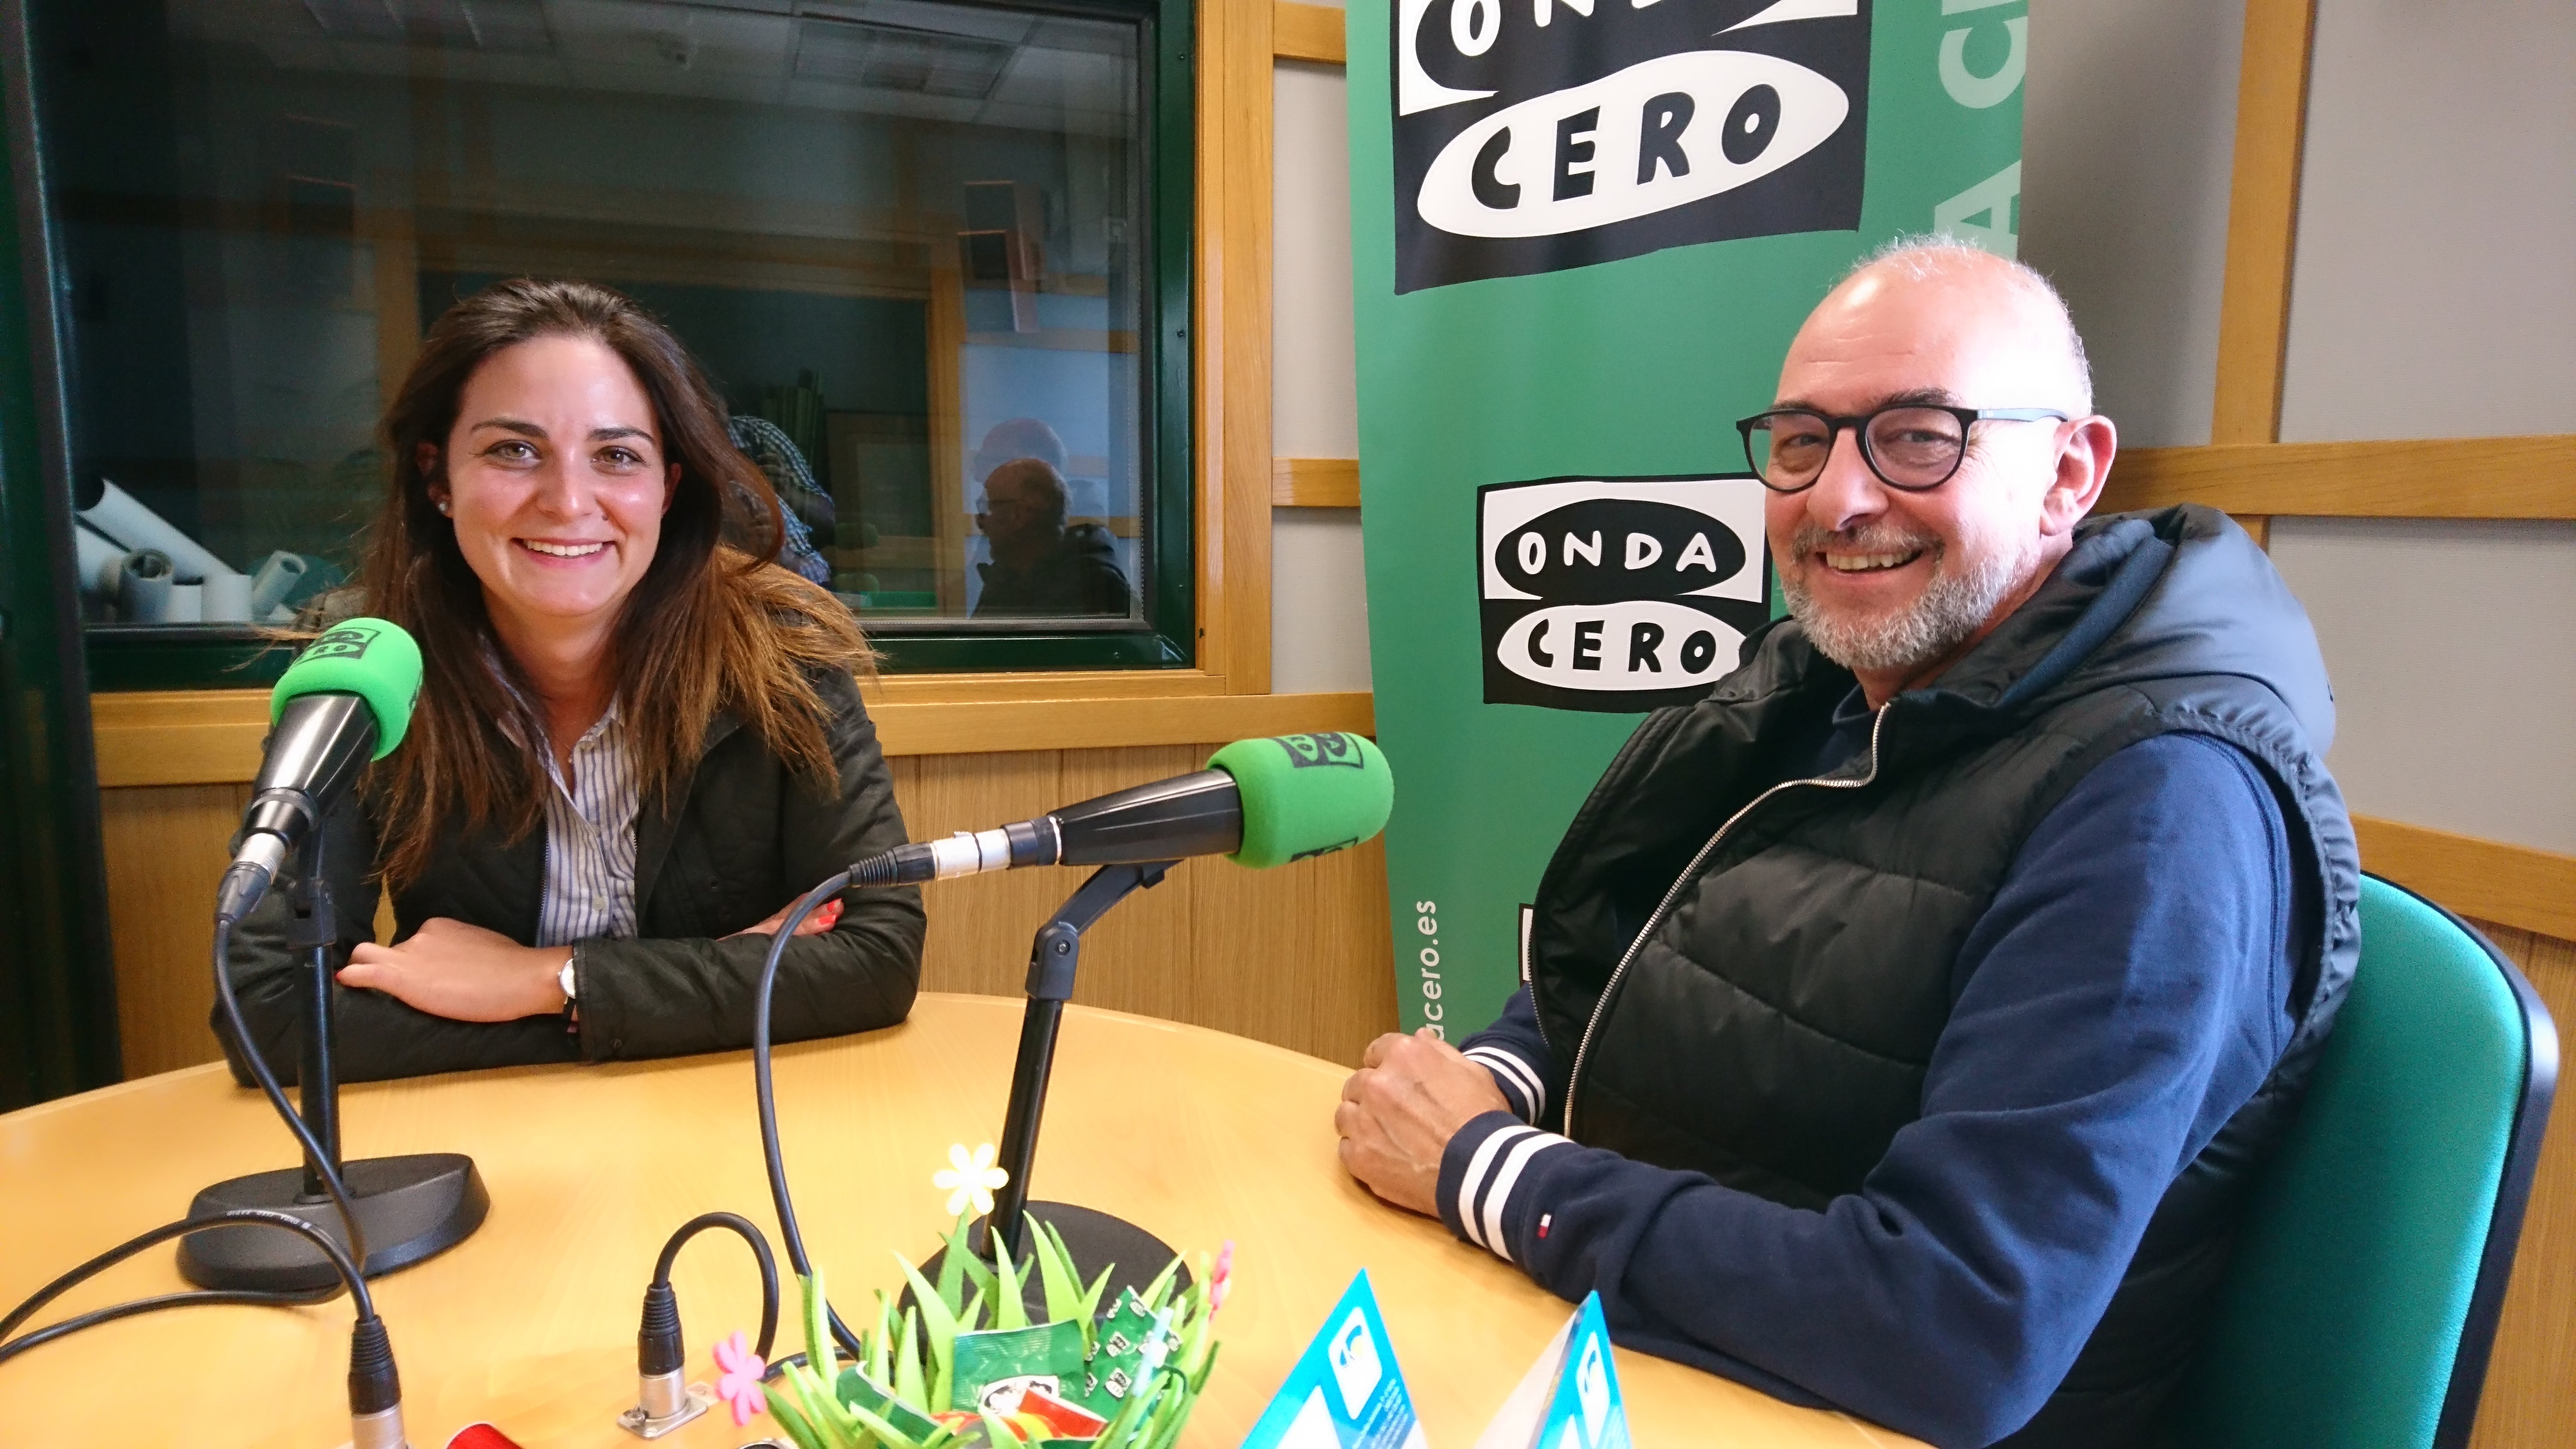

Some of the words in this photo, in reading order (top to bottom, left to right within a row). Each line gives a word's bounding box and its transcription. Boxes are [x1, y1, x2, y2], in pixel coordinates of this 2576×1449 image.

[1470, 83, 1781, 210] CERO
[1517, 530, 1717, 575] ONDA
[1527, 618, 1716, 675] CERO
